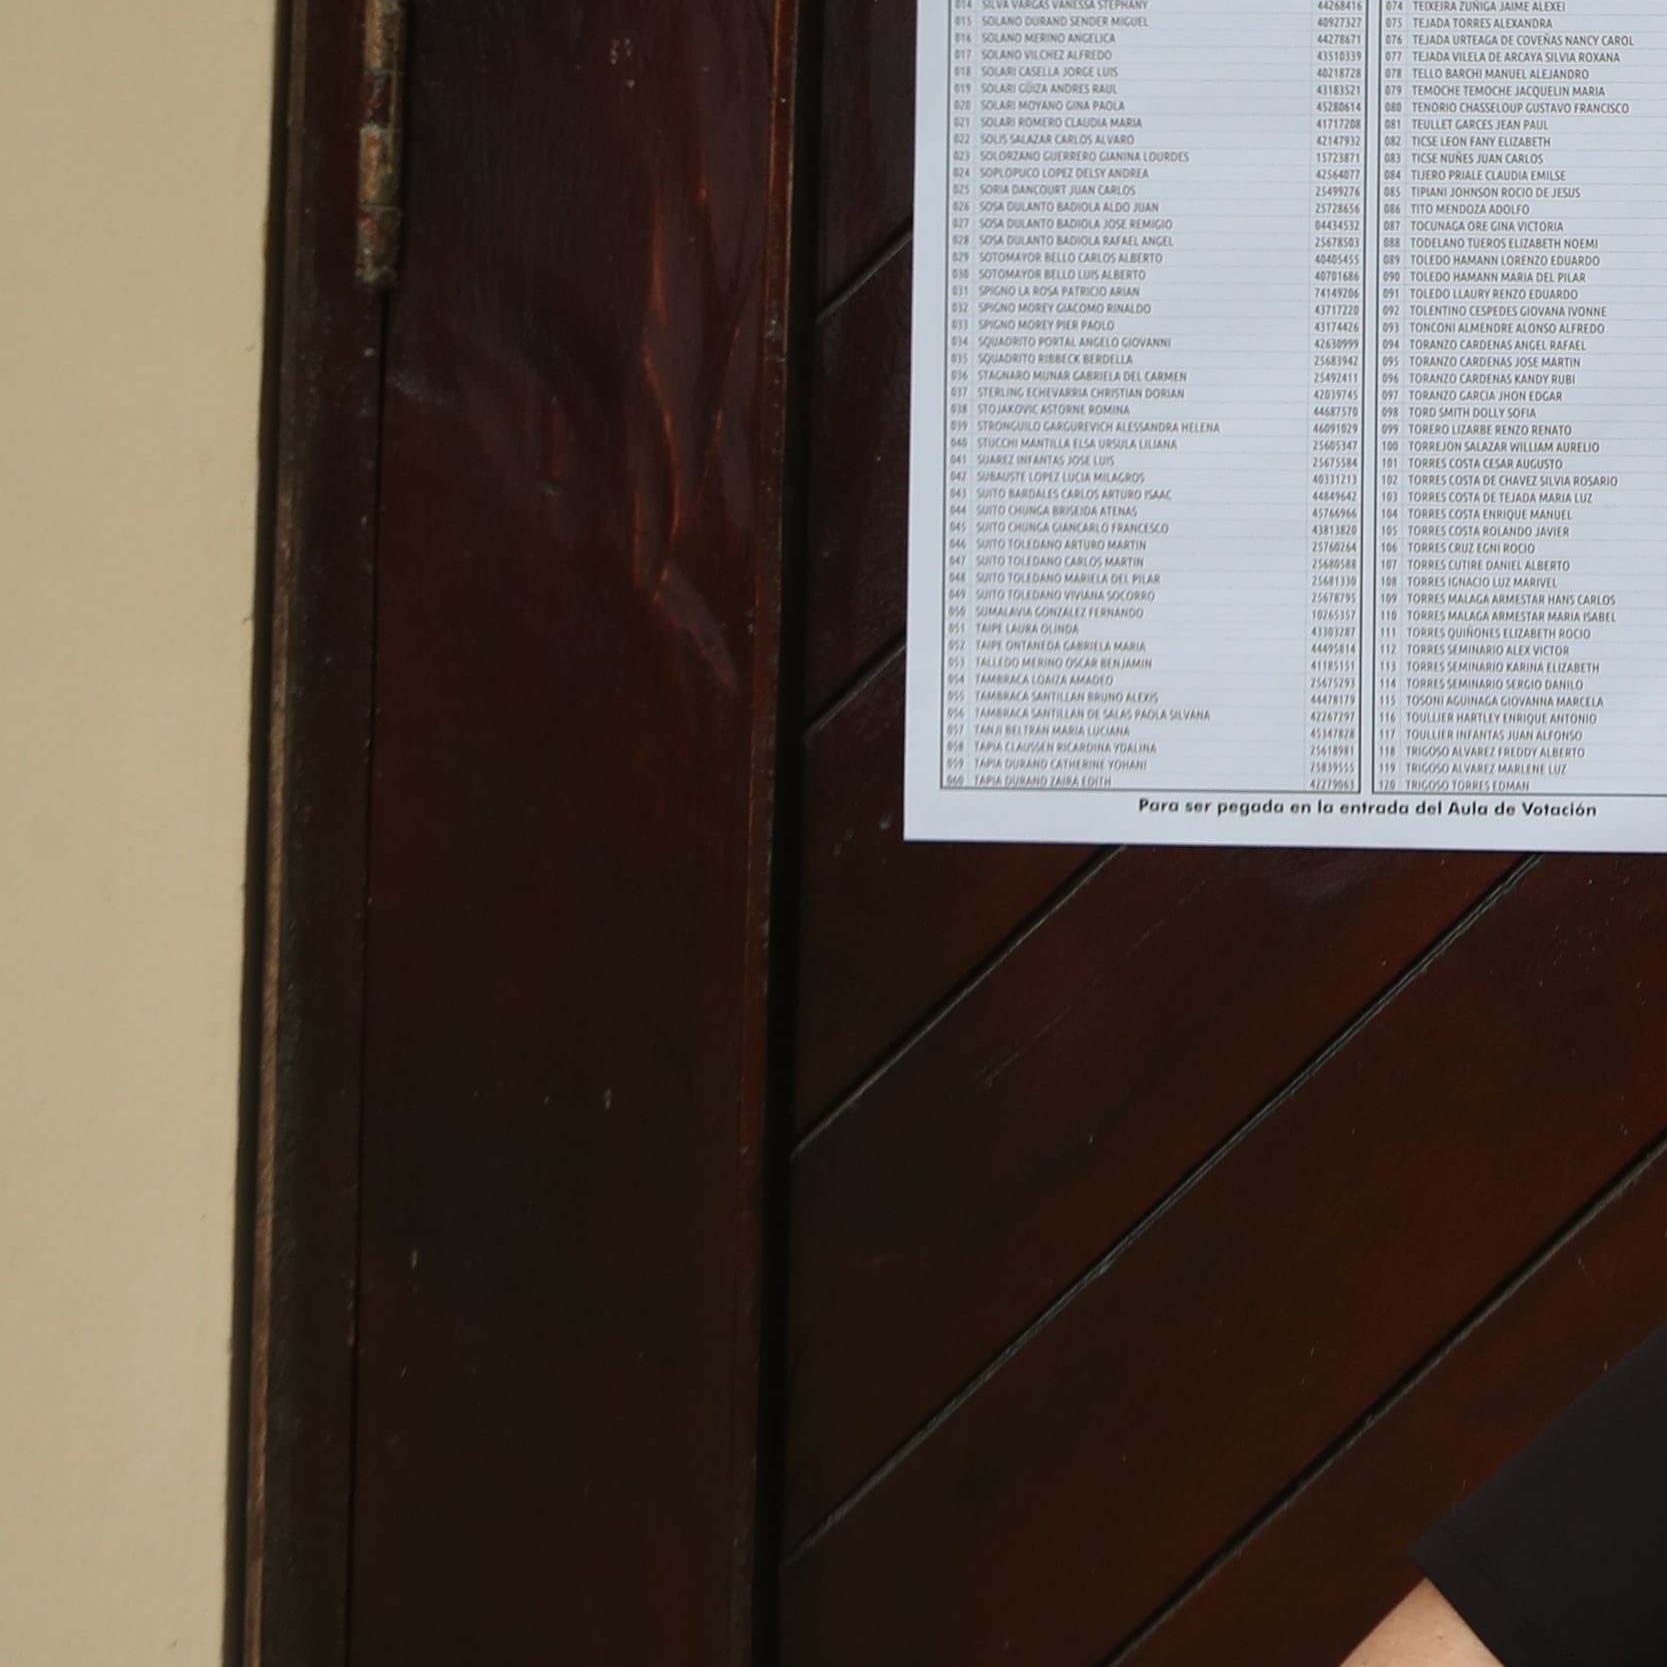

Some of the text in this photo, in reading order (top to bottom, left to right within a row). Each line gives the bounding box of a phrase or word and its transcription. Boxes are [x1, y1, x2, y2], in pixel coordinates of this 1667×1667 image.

[1139, 798, 1596, 816] Para ser pegada en la entrada del Aula de Votación
